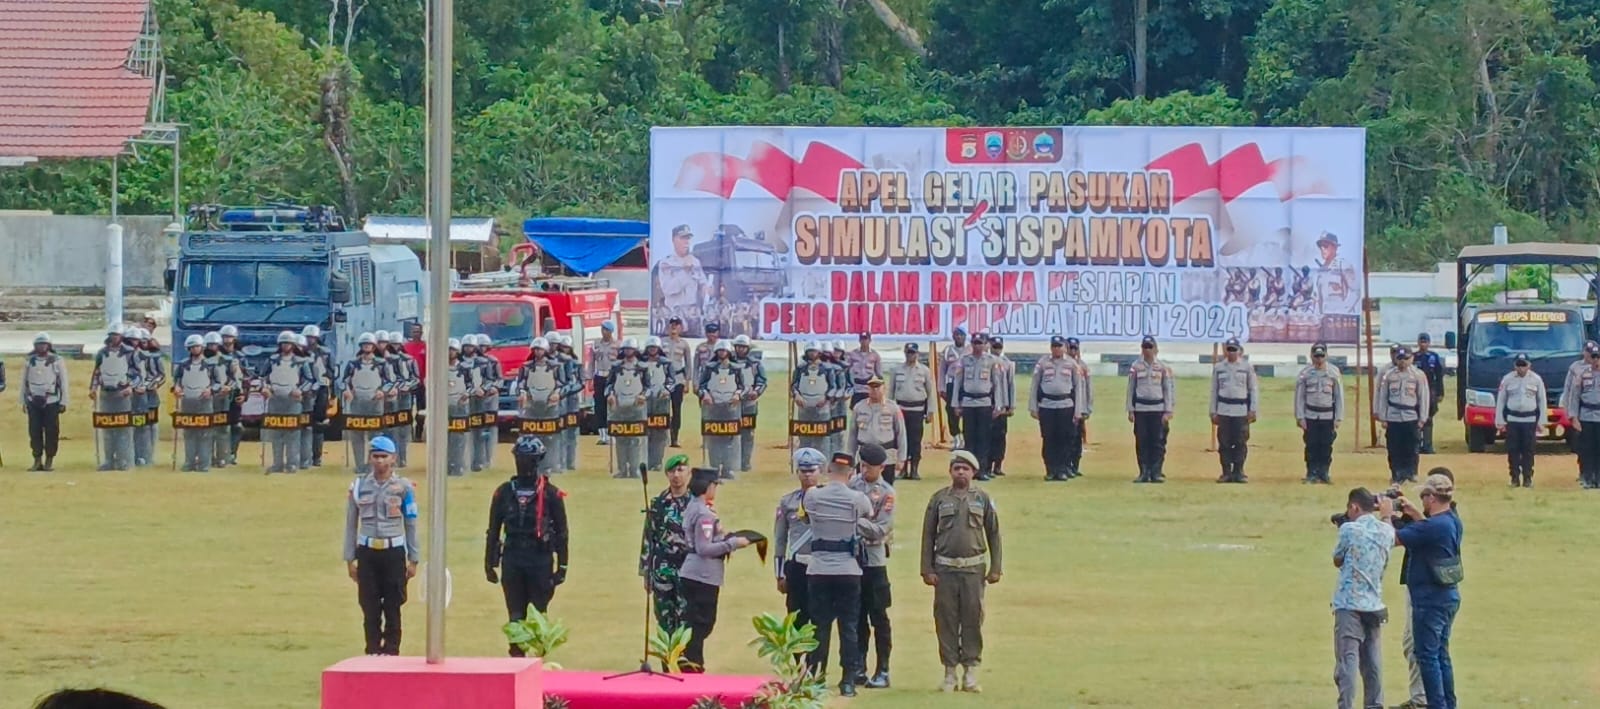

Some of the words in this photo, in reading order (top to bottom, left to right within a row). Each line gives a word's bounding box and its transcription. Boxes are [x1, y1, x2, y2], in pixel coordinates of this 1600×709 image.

[839, 171, 911, 213] APEL
[923, 171, 1017, 214] GELAR
[1029, 171, 1170, 214] PASUKAN
[794, 215, 968, 265] SIMULASI
[982, 216, 1214, 267] SISPAMKOTA
[830, 270, 920, 302] DALAM
[930, 271, 1037, 303] RANGKA
[1048, 271, 1176, 304] KESIAPAN
[763, 302, 941, 335] PENGAMANAN
[952, 303, 1062, 336] PILKADA
[1072, 304, 1160, 337] TAHUN
[1170, 305, 1244, 339] 2024
[96, 414, 129, 425] POLISI
[175, 415, 210, 426] POLISI
[264, 416, 297, 427] POLISI
[346, 417, 380, 428] POLISI
[522, 421, 556, 432] POLISI
[610, 423, 645, 434] POLISI
[704, 422, 739, 433] POLISI
[793, 422, 828, 433] POLISI
